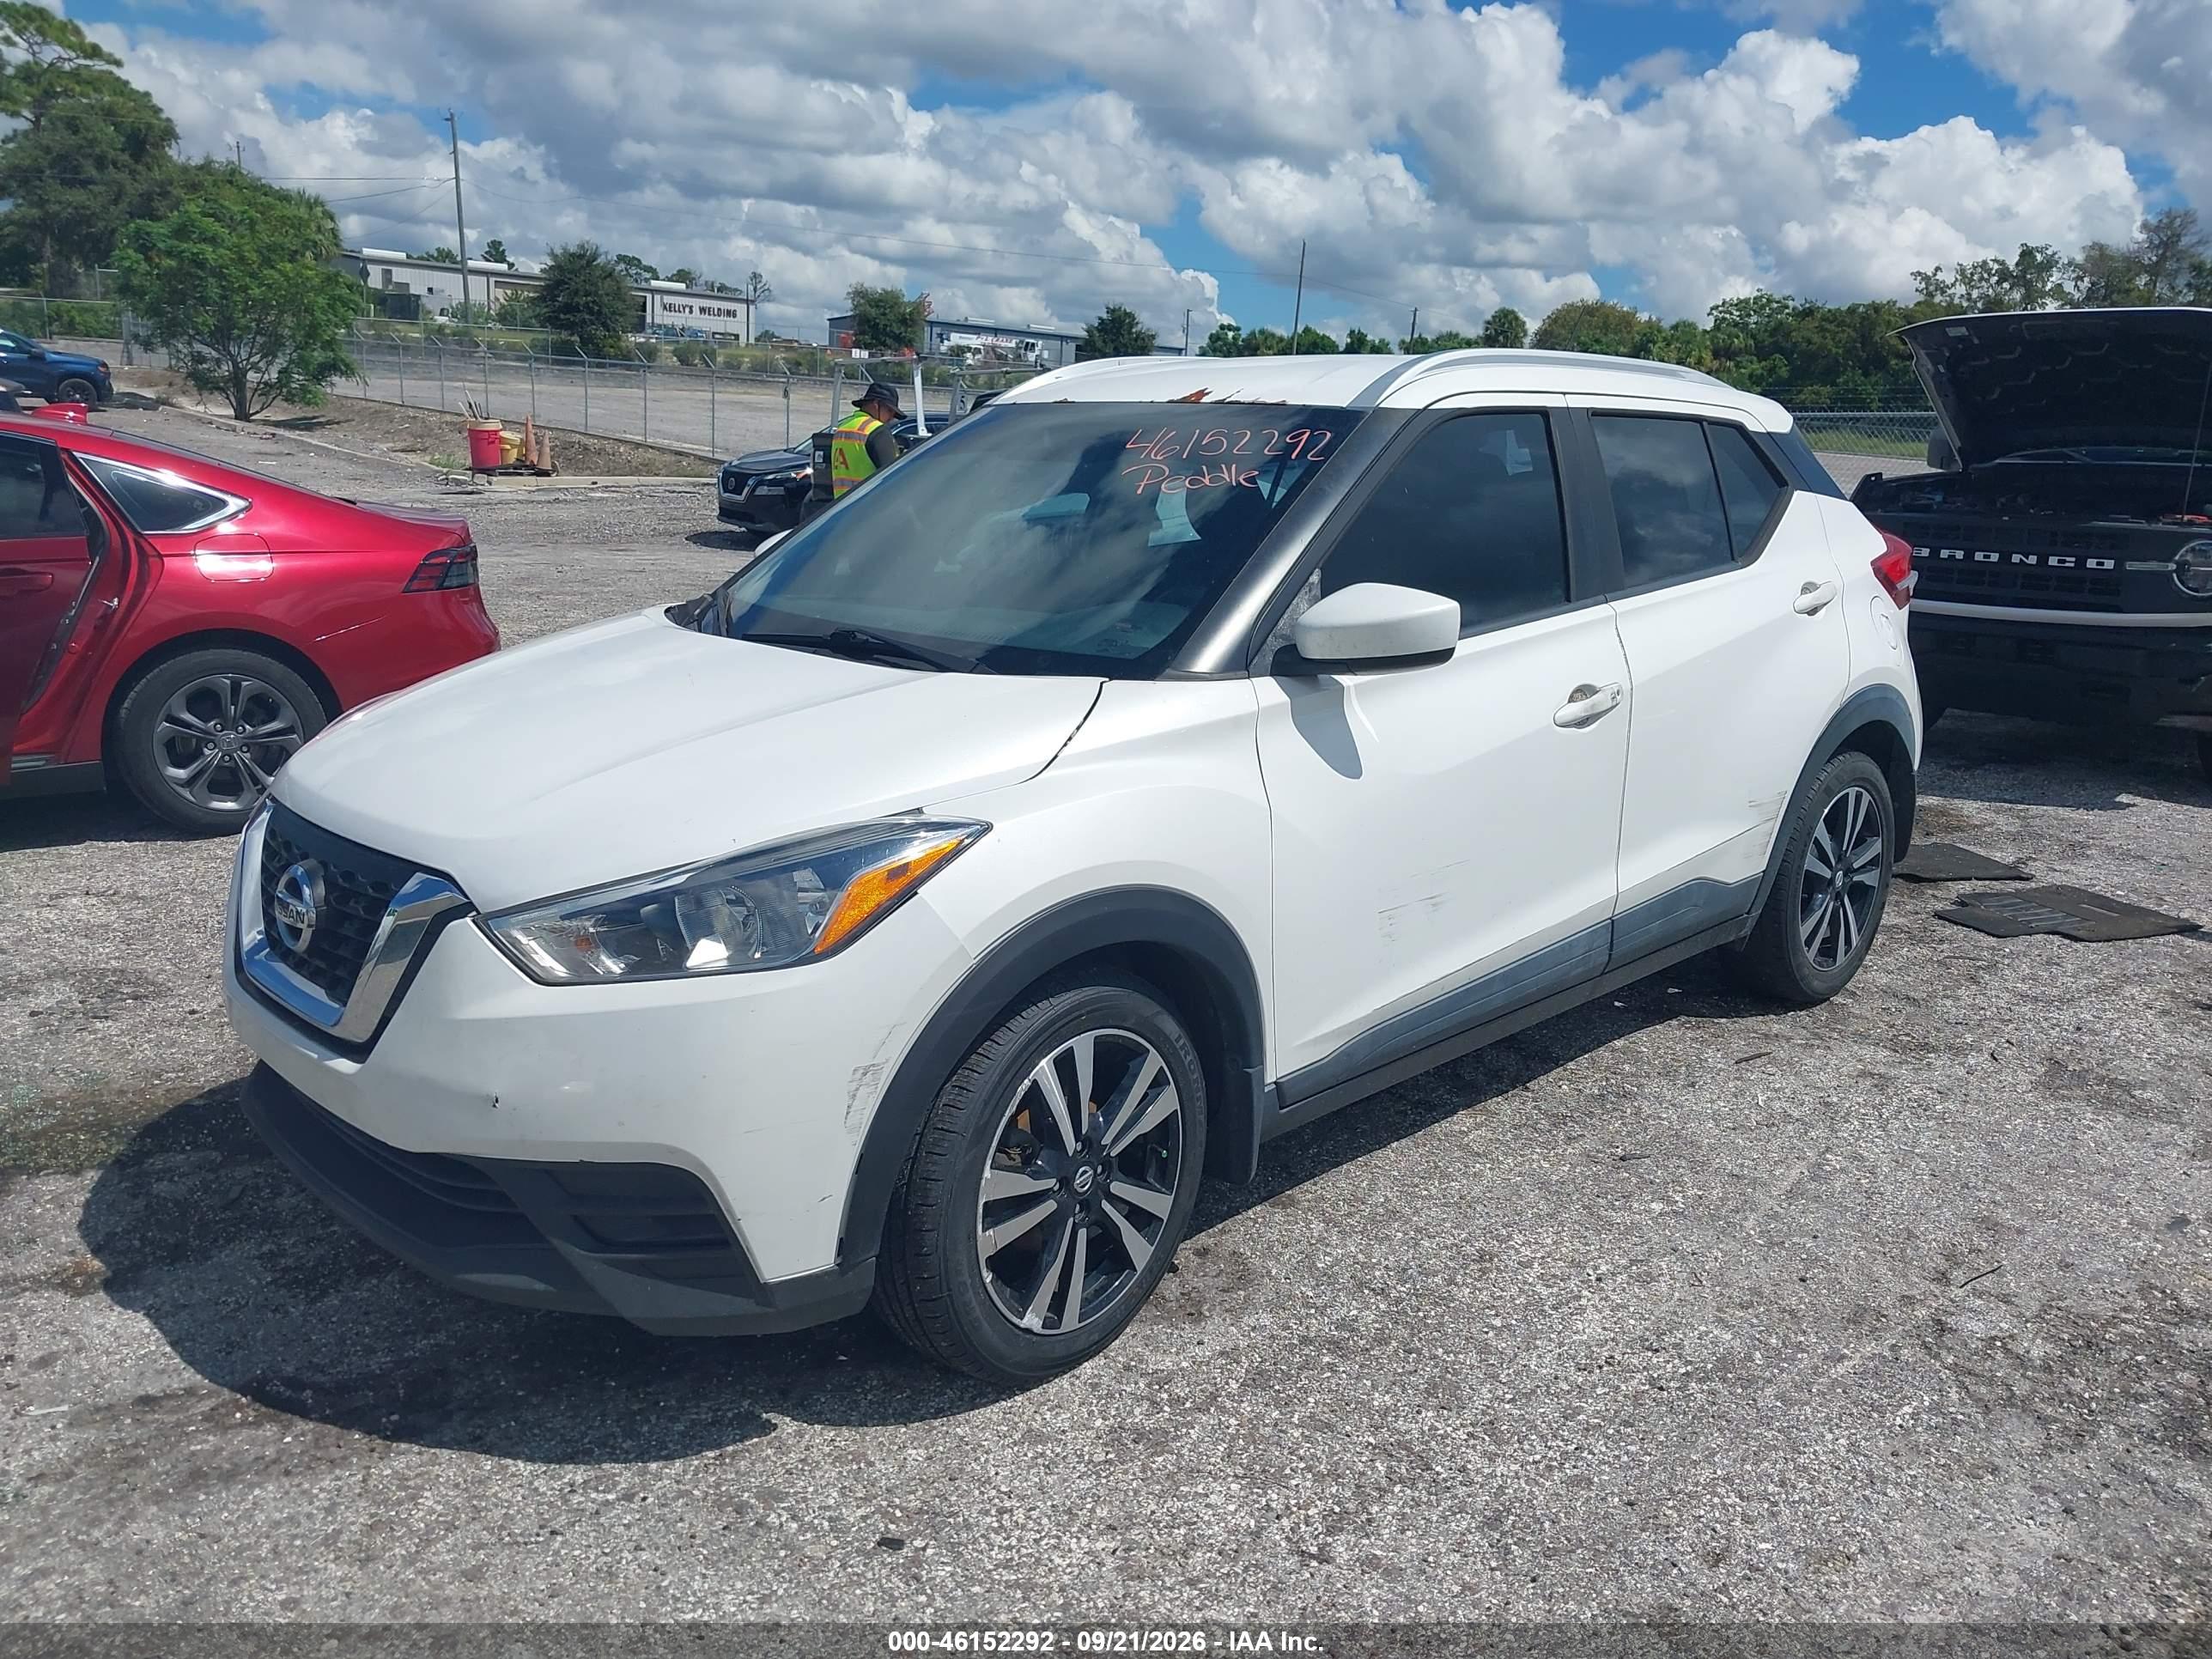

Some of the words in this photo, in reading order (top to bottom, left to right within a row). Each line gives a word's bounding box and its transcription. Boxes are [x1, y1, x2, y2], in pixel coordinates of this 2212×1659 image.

[663, 302, 694, 315] KELLY'S
[698, 306, 737, 319] WELDING
[1125, 427, 1332, 460] 46152292
[1121, 463, 1259, 495] Peddle
[1912, 546, 2115, 569] BRONCO
